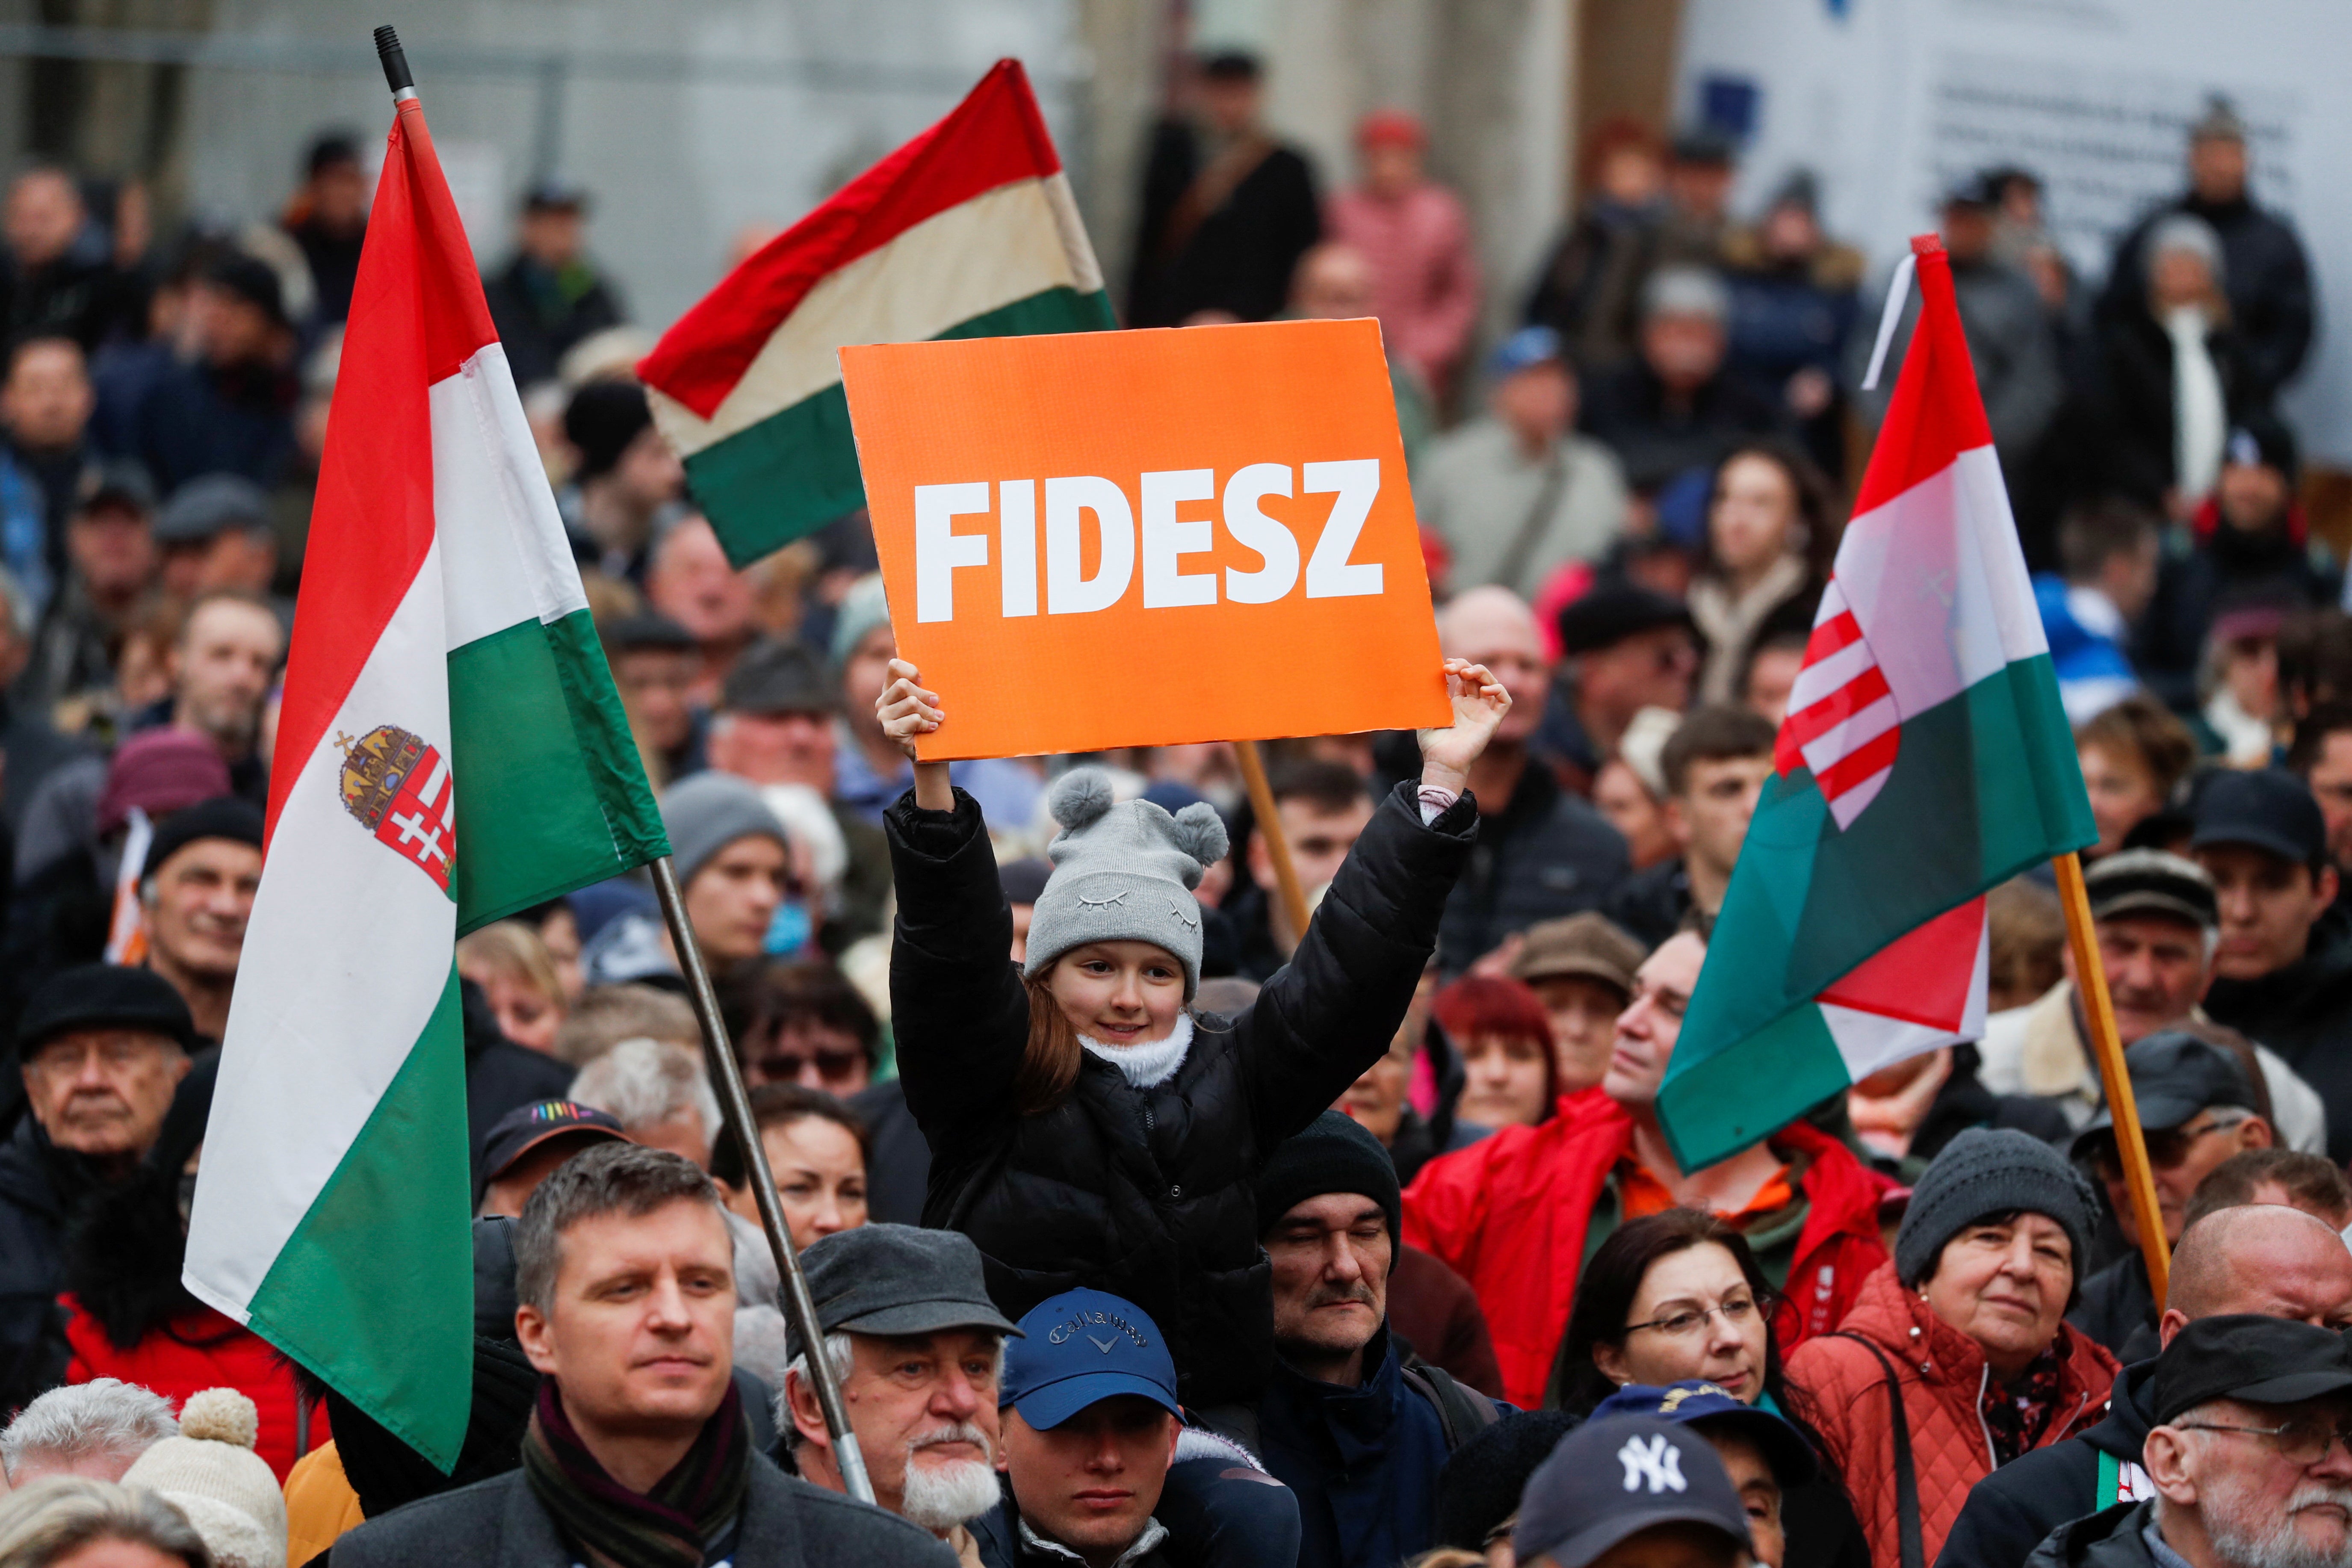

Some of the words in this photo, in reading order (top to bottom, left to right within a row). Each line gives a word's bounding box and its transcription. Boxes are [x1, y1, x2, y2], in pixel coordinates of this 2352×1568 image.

[915, 459, 1383, 623] FIDESZ
[1049, 1309, 1148, 1347] Callaway
[1618, 1433, 1687, 1493] NY
